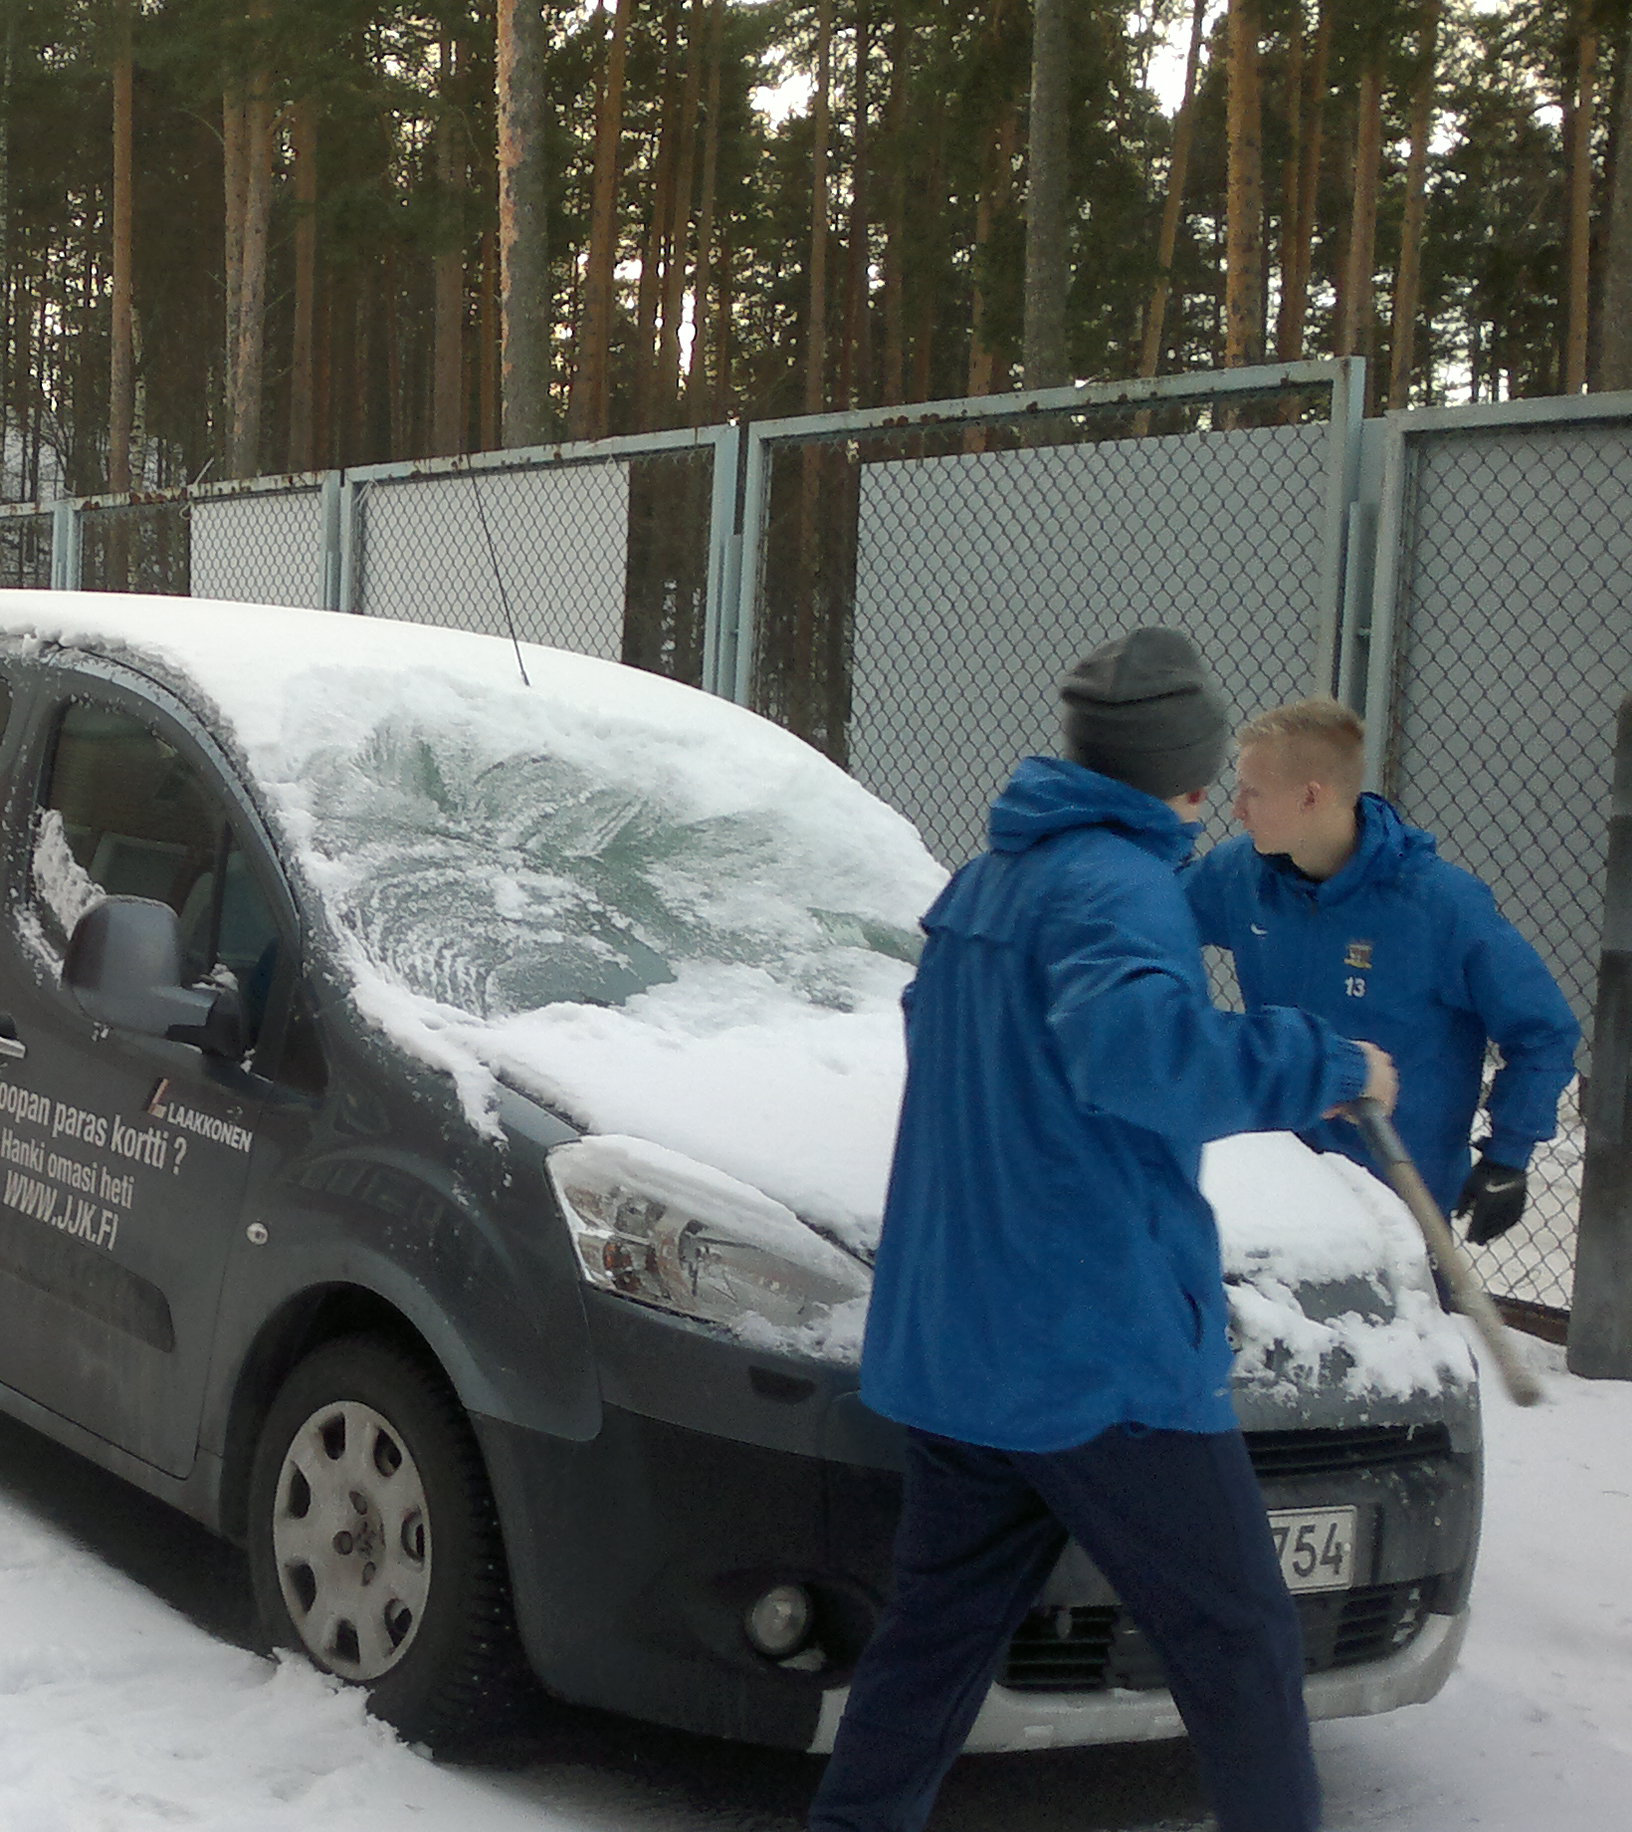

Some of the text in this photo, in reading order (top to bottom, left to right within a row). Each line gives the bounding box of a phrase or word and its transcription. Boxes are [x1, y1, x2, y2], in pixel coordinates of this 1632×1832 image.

[1344, 976, 1367, 998] 13
[52, 1101, 108, 1147] paras
[110, 1115, 169, 1169] kortti
[172, 1136, 188, 1176] ?
[168, 1103, 253, 1152] LAAKKONEN
[0, 1127, 135, 1209] Hanki omasi heti
[3, 1170, 119, 1250] WWW.JJK.FI
[1272, 1522, 1343, 1577] 754
